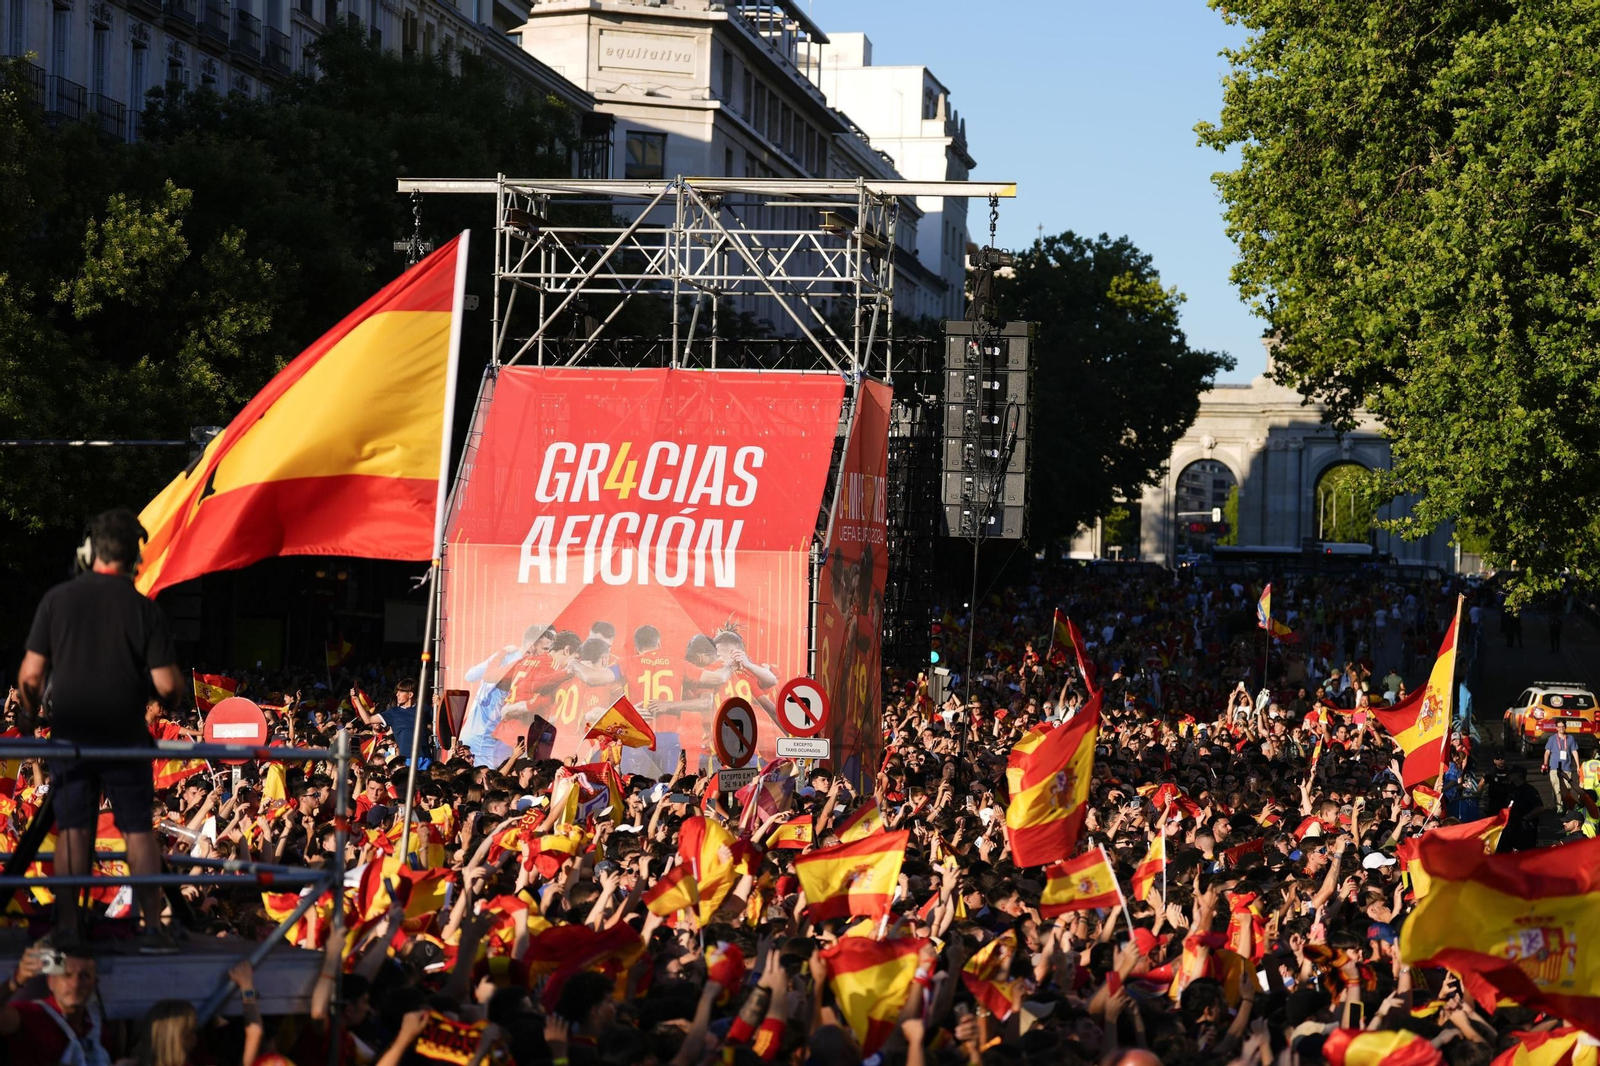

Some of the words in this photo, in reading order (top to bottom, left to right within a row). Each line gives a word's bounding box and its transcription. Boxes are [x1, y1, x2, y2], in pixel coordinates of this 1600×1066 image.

[606, 47, 692, 63] equitativa
[534, 441, 765, 507] GR4CIAS
[838, 525, 857, 541] UEFA
[517, 507, 745, 588] AFICIÓN
[637, 669, 674, 709] 16
[721, 773, 742, 781] EXCEPTO
